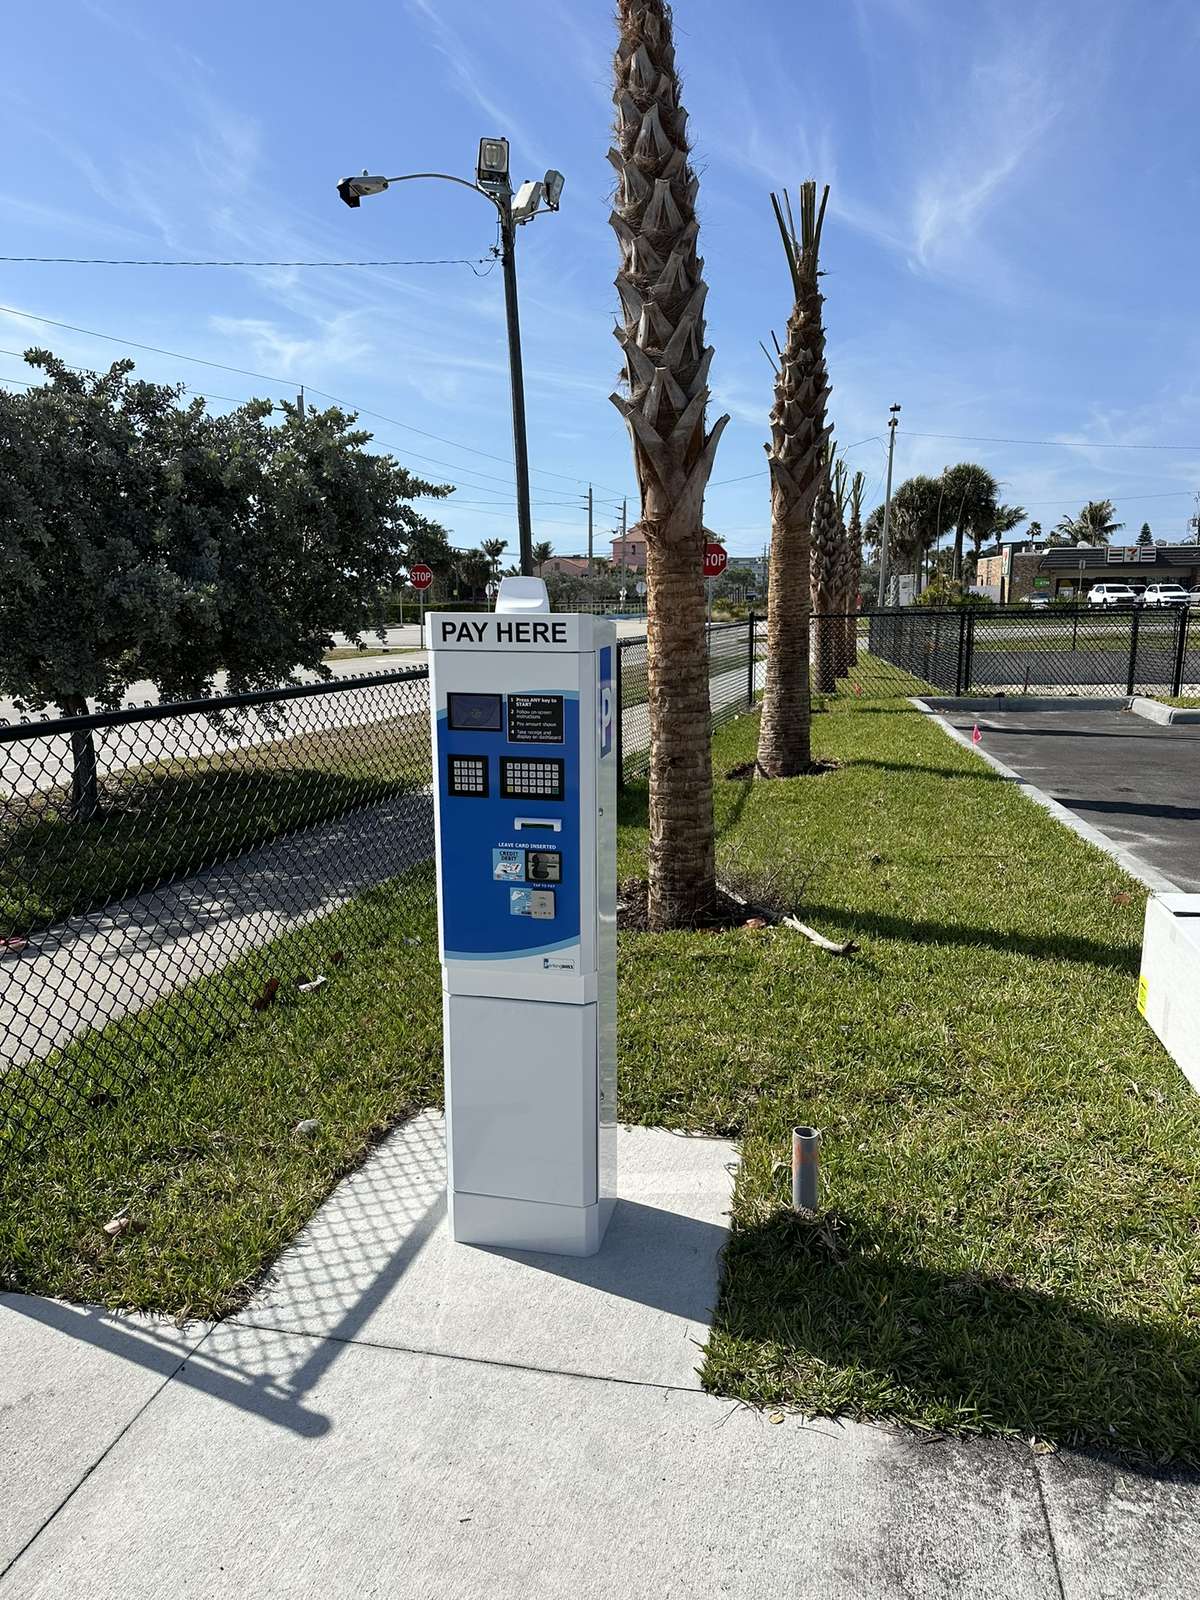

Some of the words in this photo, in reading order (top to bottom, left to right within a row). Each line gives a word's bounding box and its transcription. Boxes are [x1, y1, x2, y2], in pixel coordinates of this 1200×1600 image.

[705, 553, 725, 566] TOP
[411, 571, 431, 582] STOP
[441, 621, 488, 642] PAY
[496, 622, 567, 643] HERE
[601, 687, 612, 747] P
